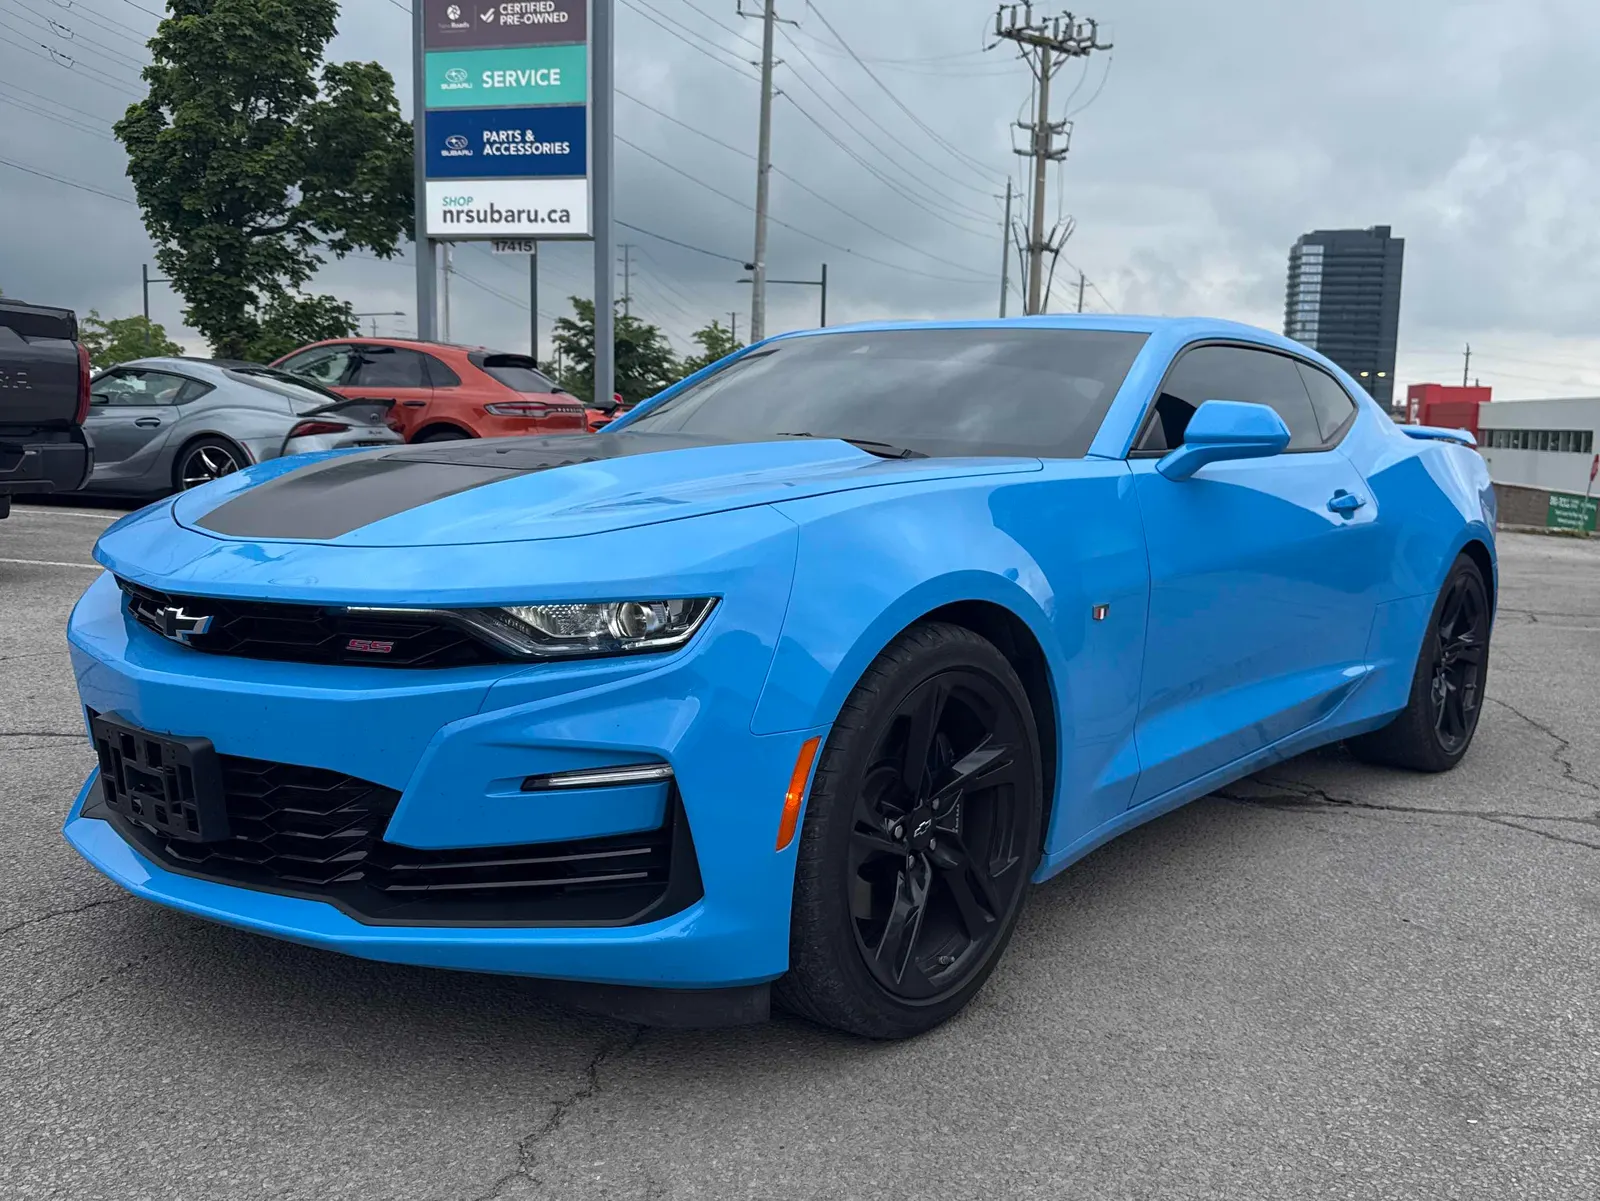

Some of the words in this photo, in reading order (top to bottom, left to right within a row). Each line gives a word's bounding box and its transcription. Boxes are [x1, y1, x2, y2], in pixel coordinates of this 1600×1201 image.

[500, 2, 555, 14] CERTIFIED
[500, 12, 568, 26] PRE-OWNED
[482, 68, 561, 88] SERVICE
[483, 130, 522, 142] PARTS
[525, 129, 535, 142] &
[483, 142, 570, 156] ACCESSORIES
[442, 196, 474, 207] SHOP
[443, 202, 570, 223] nrsubaru.ca
[495, 241, 533, 252] 17415
[345, 639, 395, 653] SS
